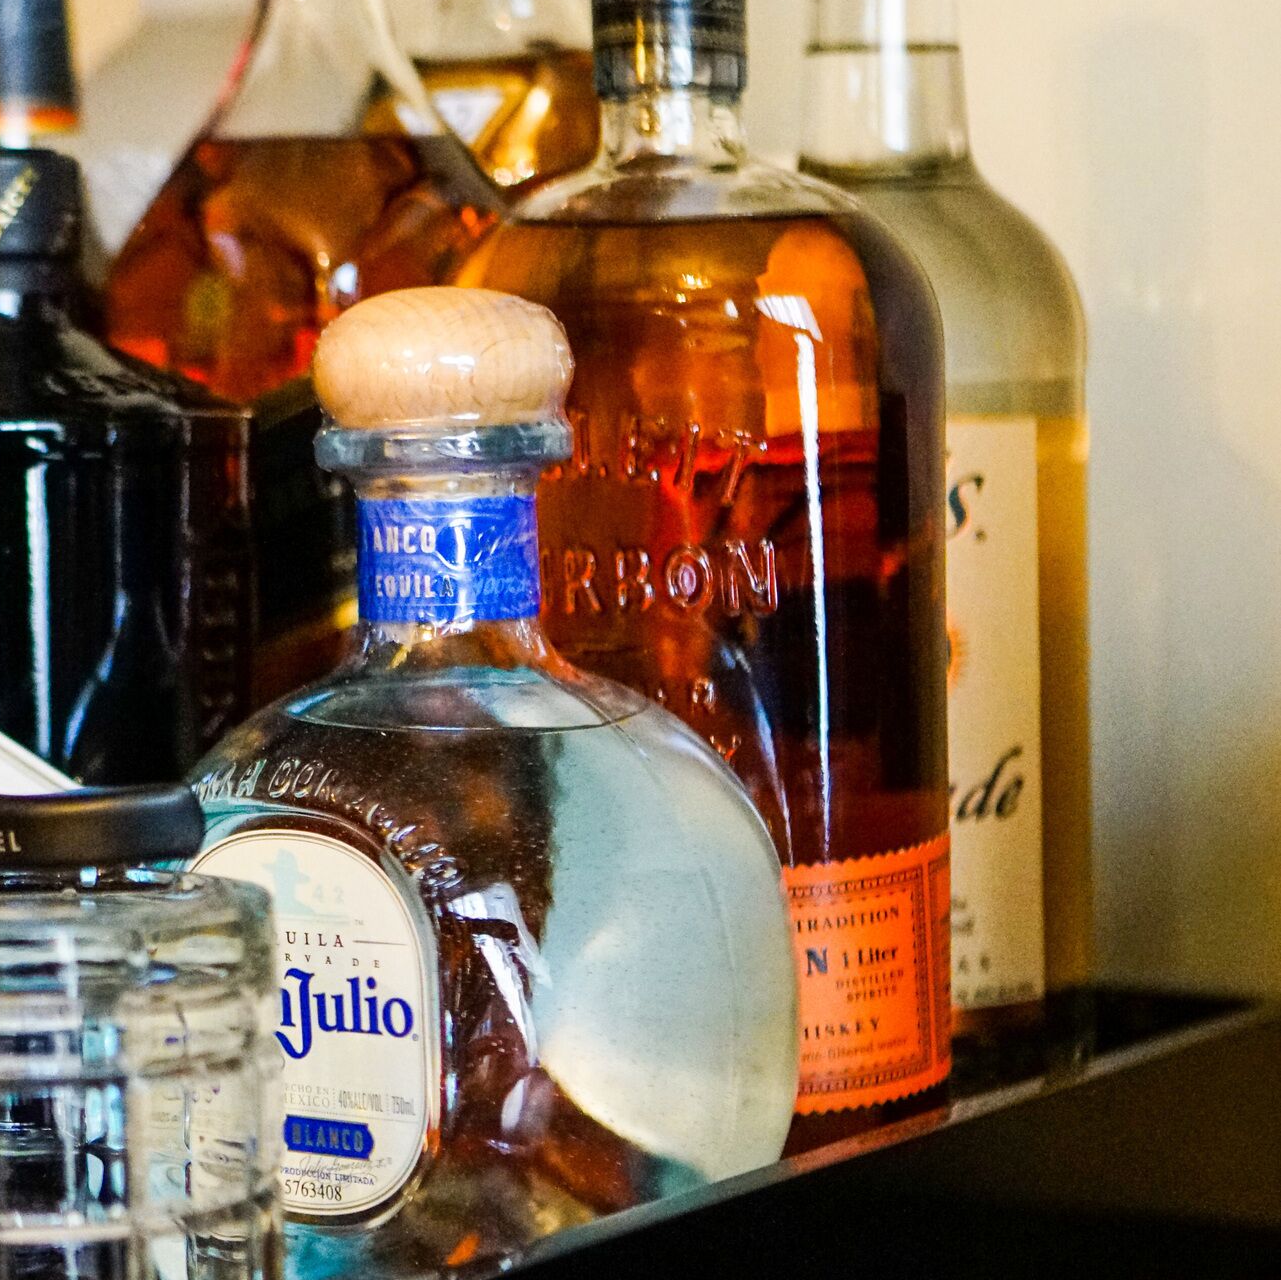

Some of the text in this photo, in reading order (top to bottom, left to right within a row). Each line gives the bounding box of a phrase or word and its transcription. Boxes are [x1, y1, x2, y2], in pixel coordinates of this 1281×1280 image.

[286, 931, 344, 948] UILA
[352, 958, 380, 968] DE
[858, 948, 897, 966] Liter
[292, 1124, 364, 1152] BLANCO
[284, 1179, 342, 1201] 5763408
